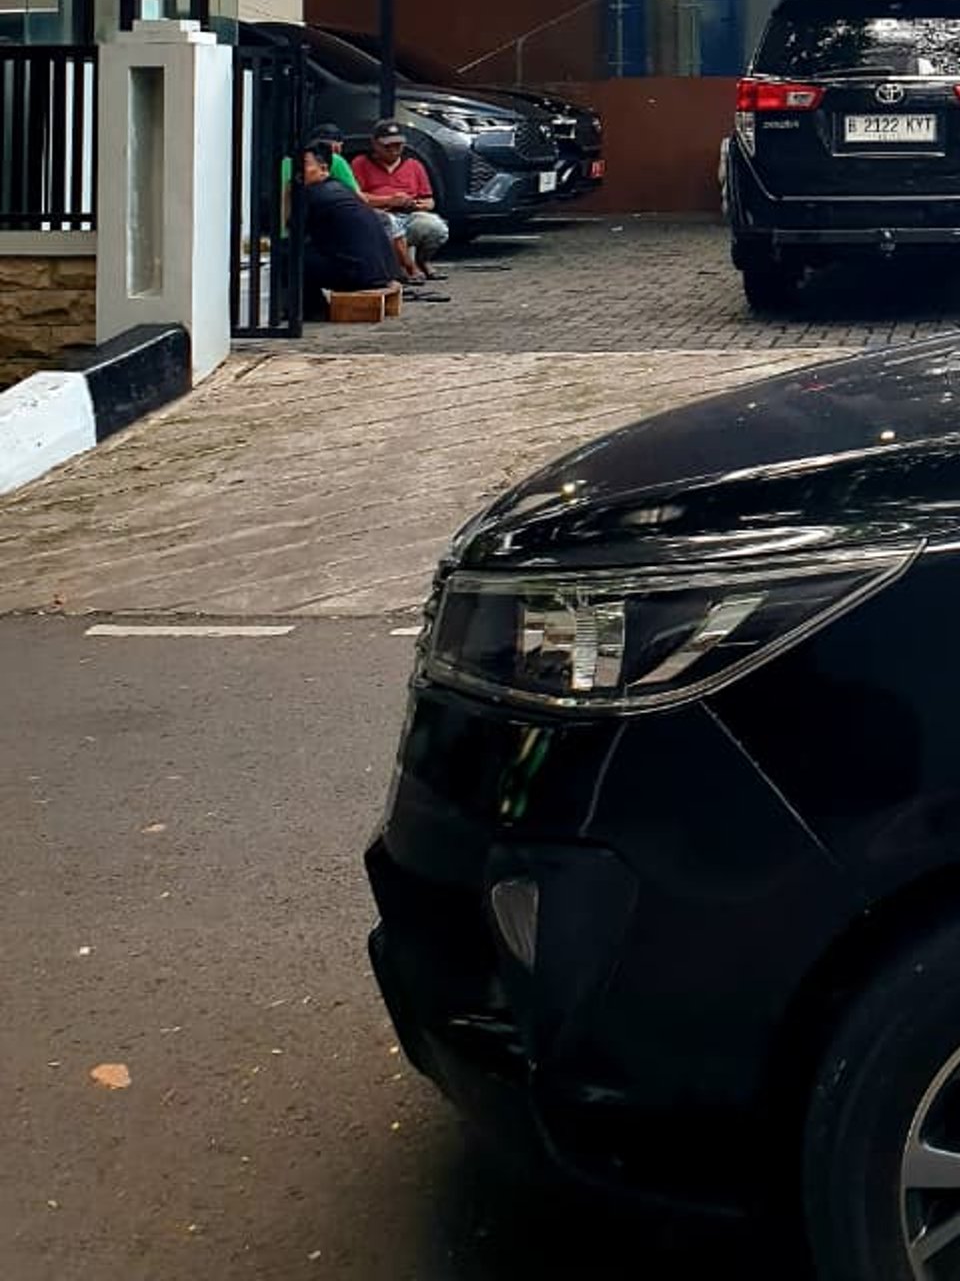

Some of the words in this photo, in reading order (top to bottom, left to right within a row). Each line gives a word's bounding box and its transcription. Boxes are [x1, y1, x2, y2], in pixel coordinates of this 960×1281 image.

[848, 117, 857, 133] B
[864, 117, 899, 132] 2122
[906, 116, 931, 132] KYT
